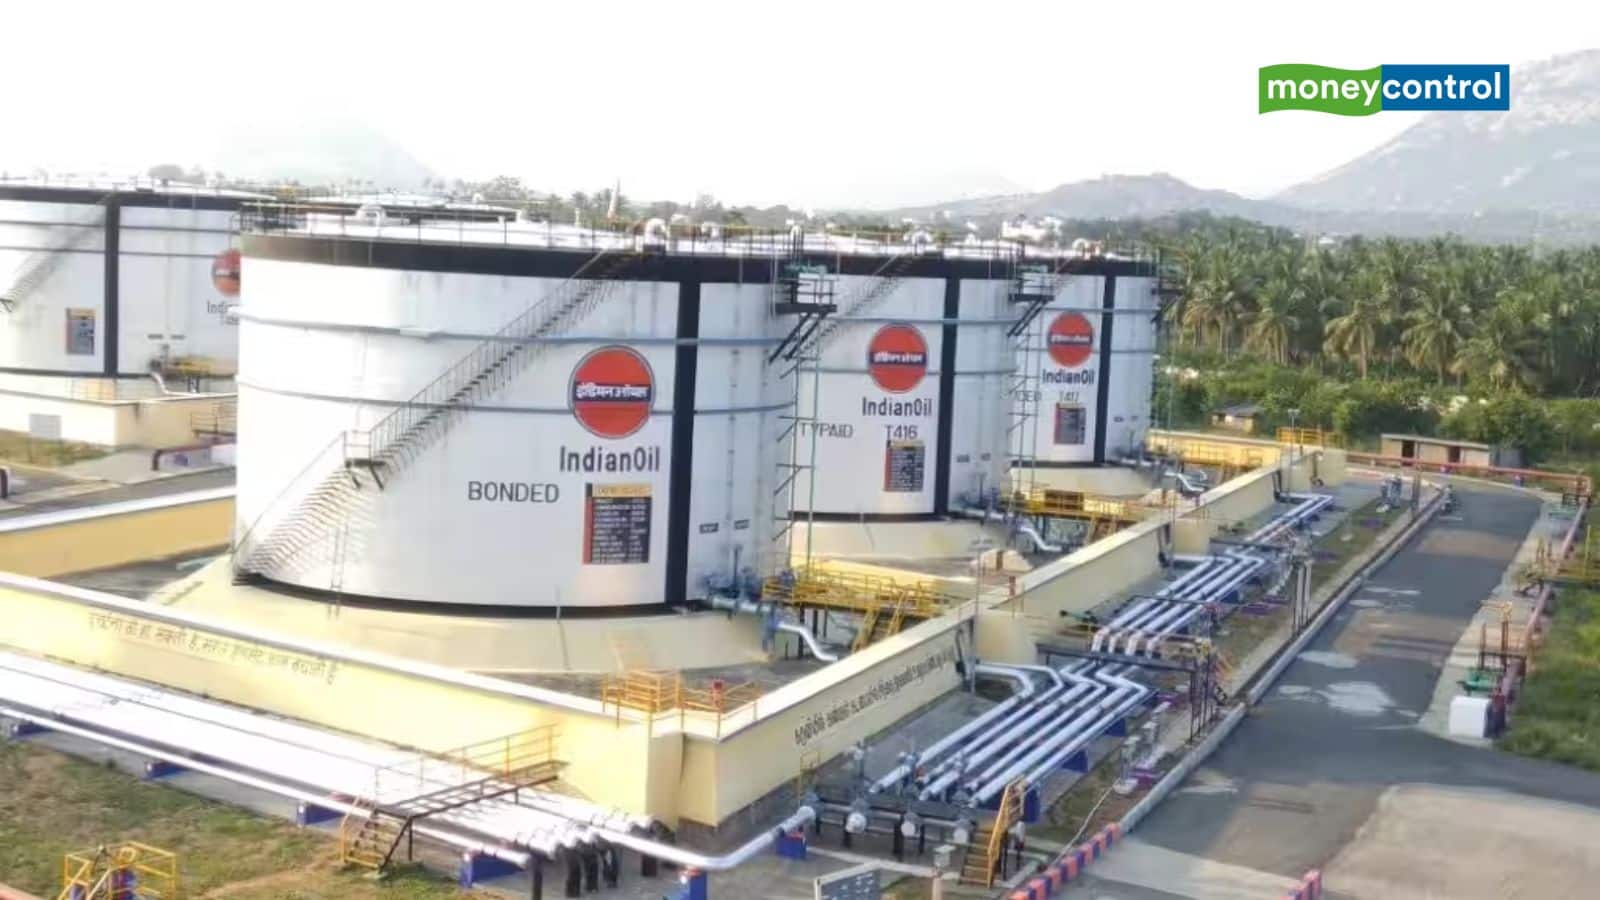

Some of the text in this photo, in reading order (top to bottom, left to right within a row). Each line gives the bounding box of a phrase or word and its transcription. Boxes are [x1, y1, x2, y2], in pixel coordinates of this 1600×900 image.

[1042, 369, 1095, 385] IndianOil
[862, 397, 933, 417] IndianOil
[801, 422, 854, 438] TYPAID
[885, 425, 918, 440] T416
[559, 446, 661, 472] IndianOil
[467, 480, 560, 503] BONDED
